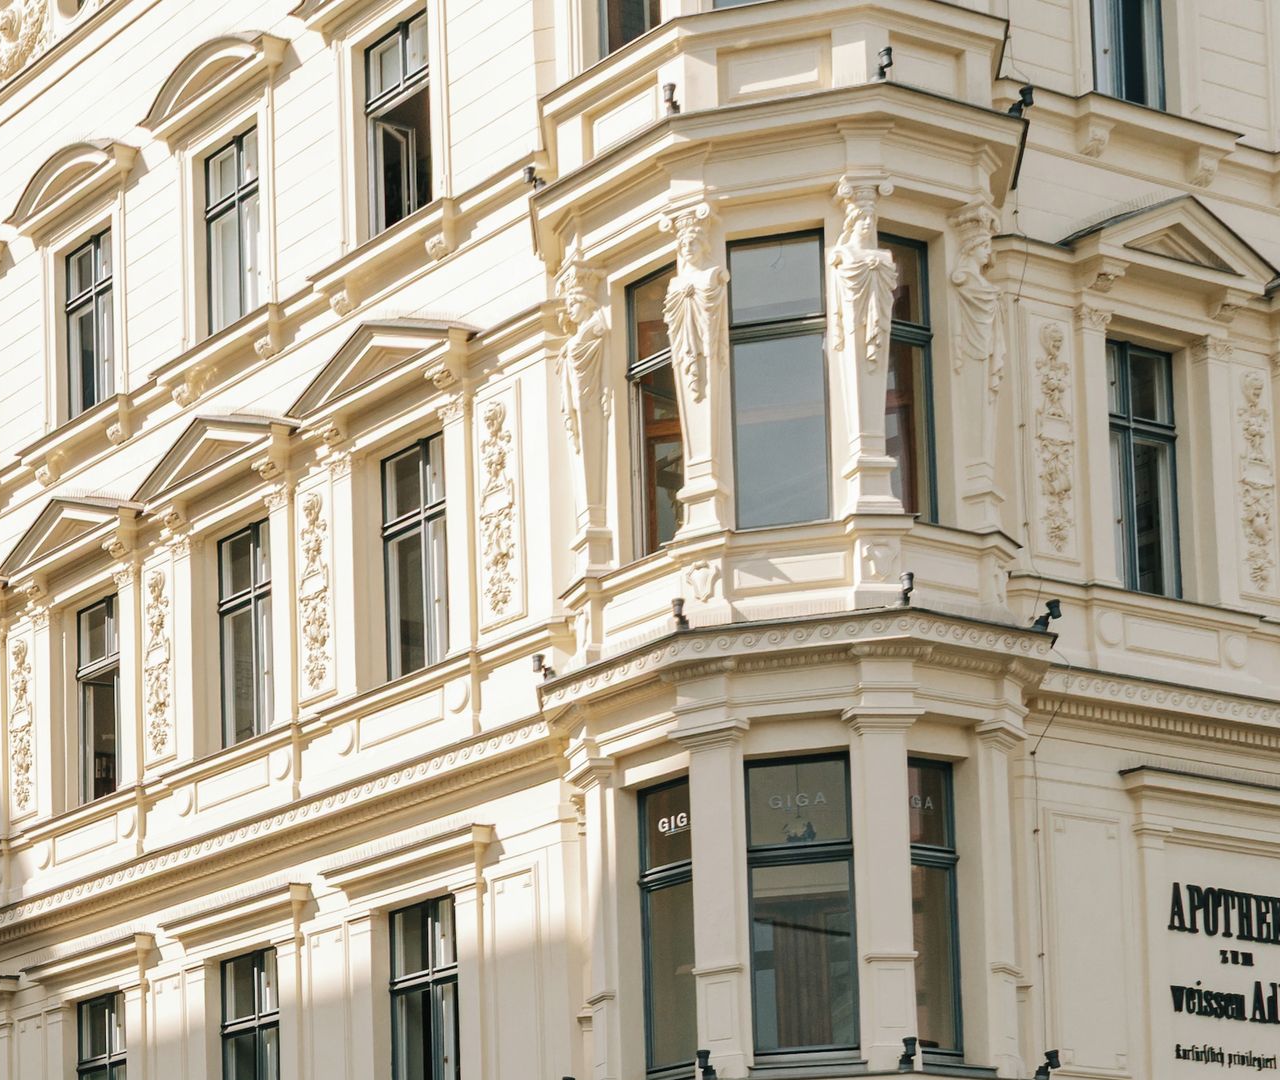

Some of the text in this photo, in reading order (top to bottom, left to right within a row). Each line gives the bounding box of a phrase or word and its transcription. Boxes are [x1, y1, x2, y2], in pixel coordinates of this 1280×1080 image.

[768, 792, 827, 809] GIGA
[911, 795, 934, 809] GA
[658, 812, 689, 832] GIG
[1220, 950, 1254, 966] zum
[1170, 980, 1247, 1020] weissen
